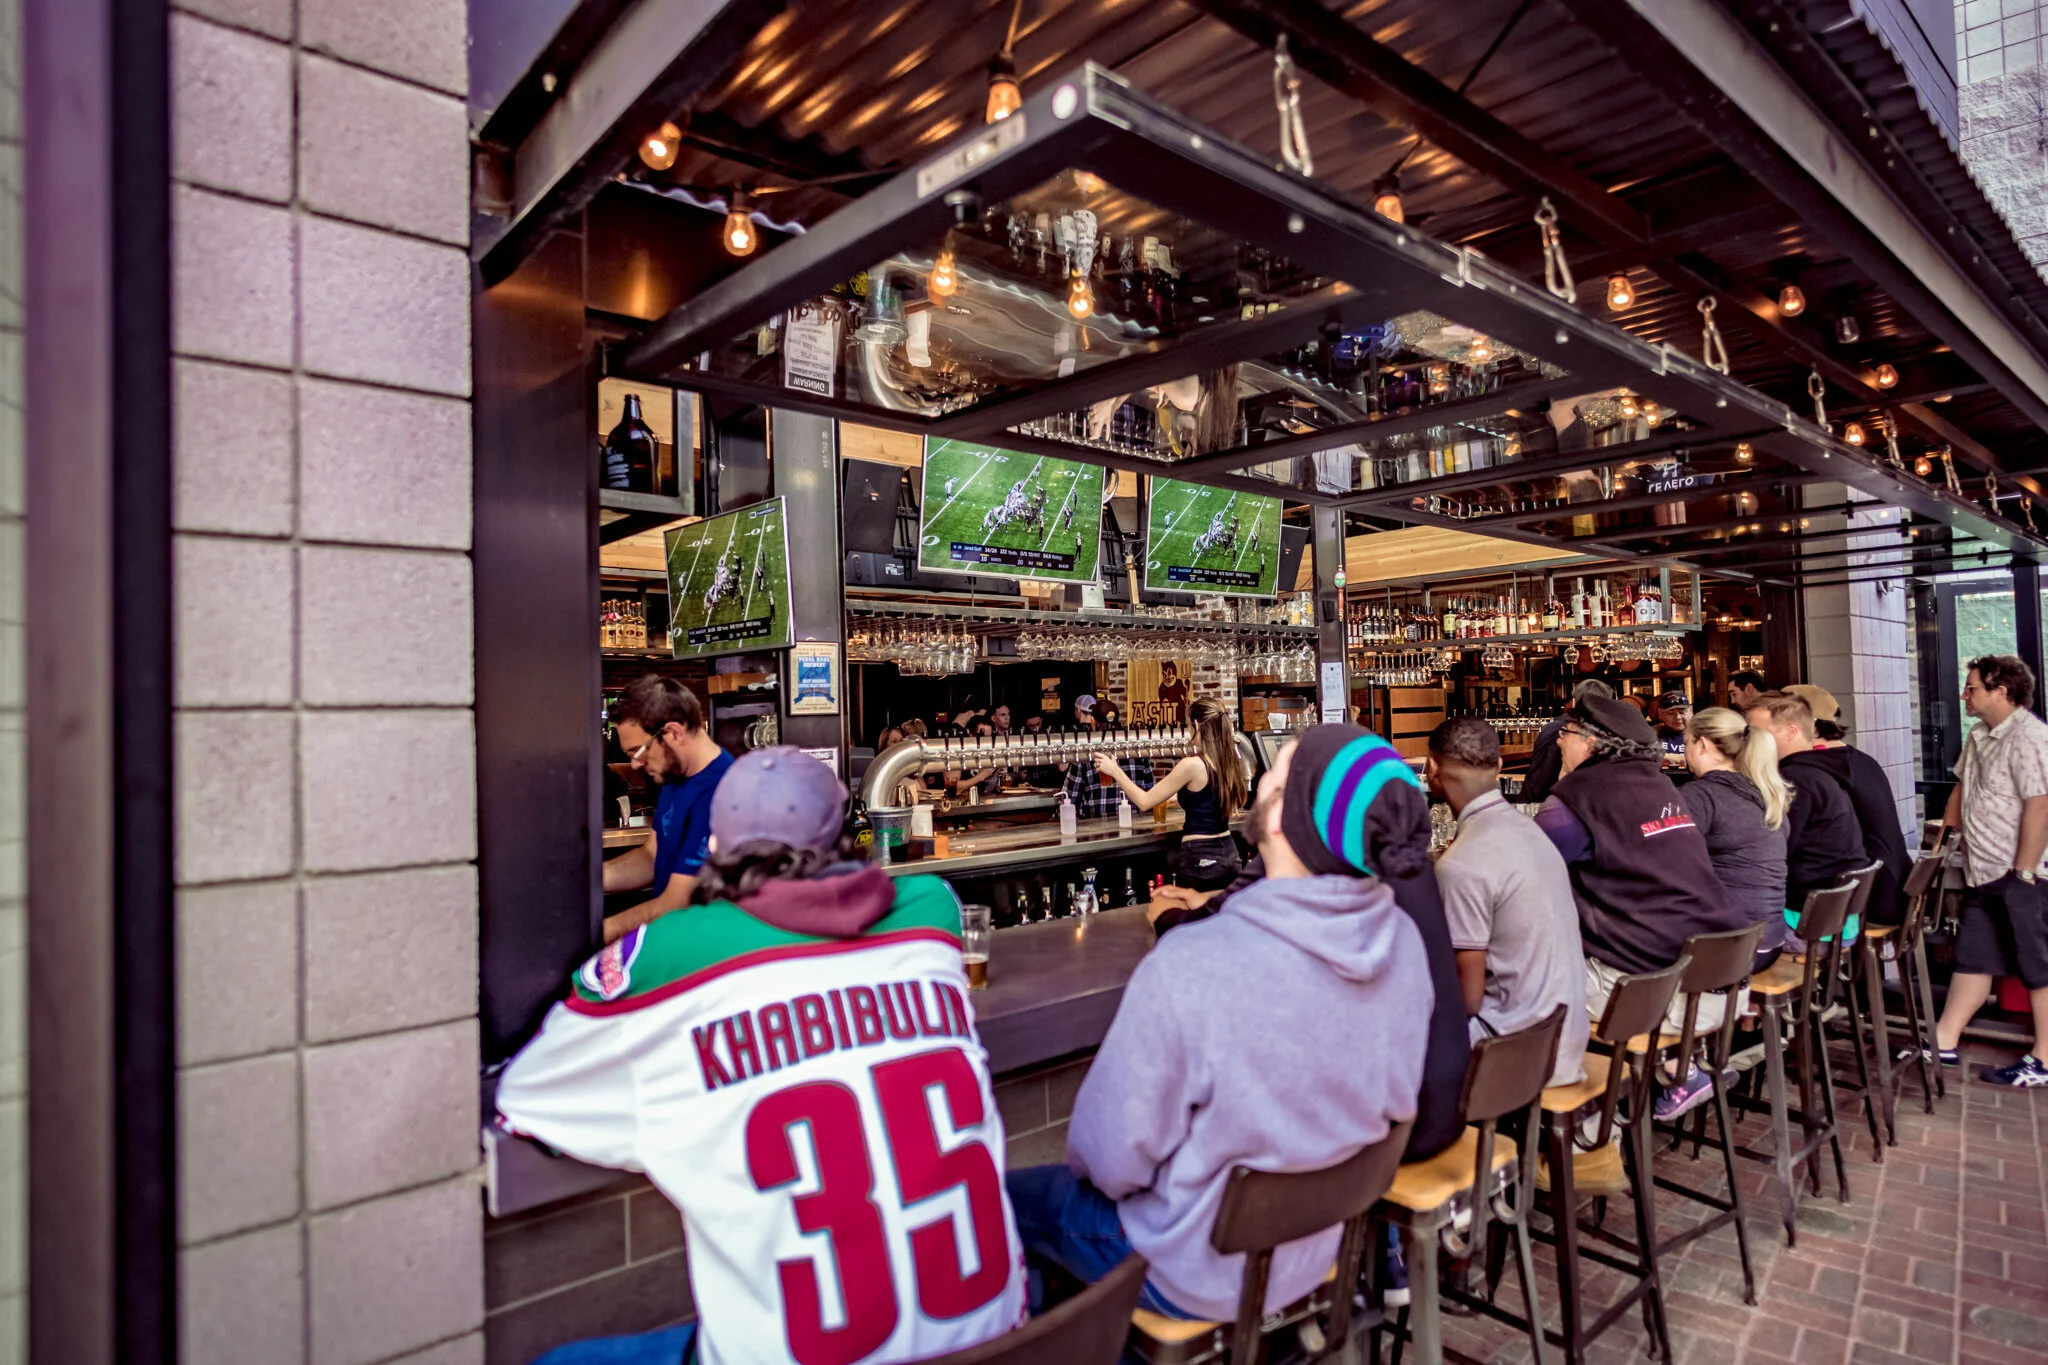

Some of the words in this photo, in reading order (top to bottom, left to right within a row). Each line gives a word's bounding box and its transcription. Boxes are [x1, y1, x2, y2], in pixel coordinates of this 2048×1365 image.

[1132, 701, 1179, 728] ASU
[1640, 819, 1662, 835] SKI
[743, 1046, 1011, 1365] 35
